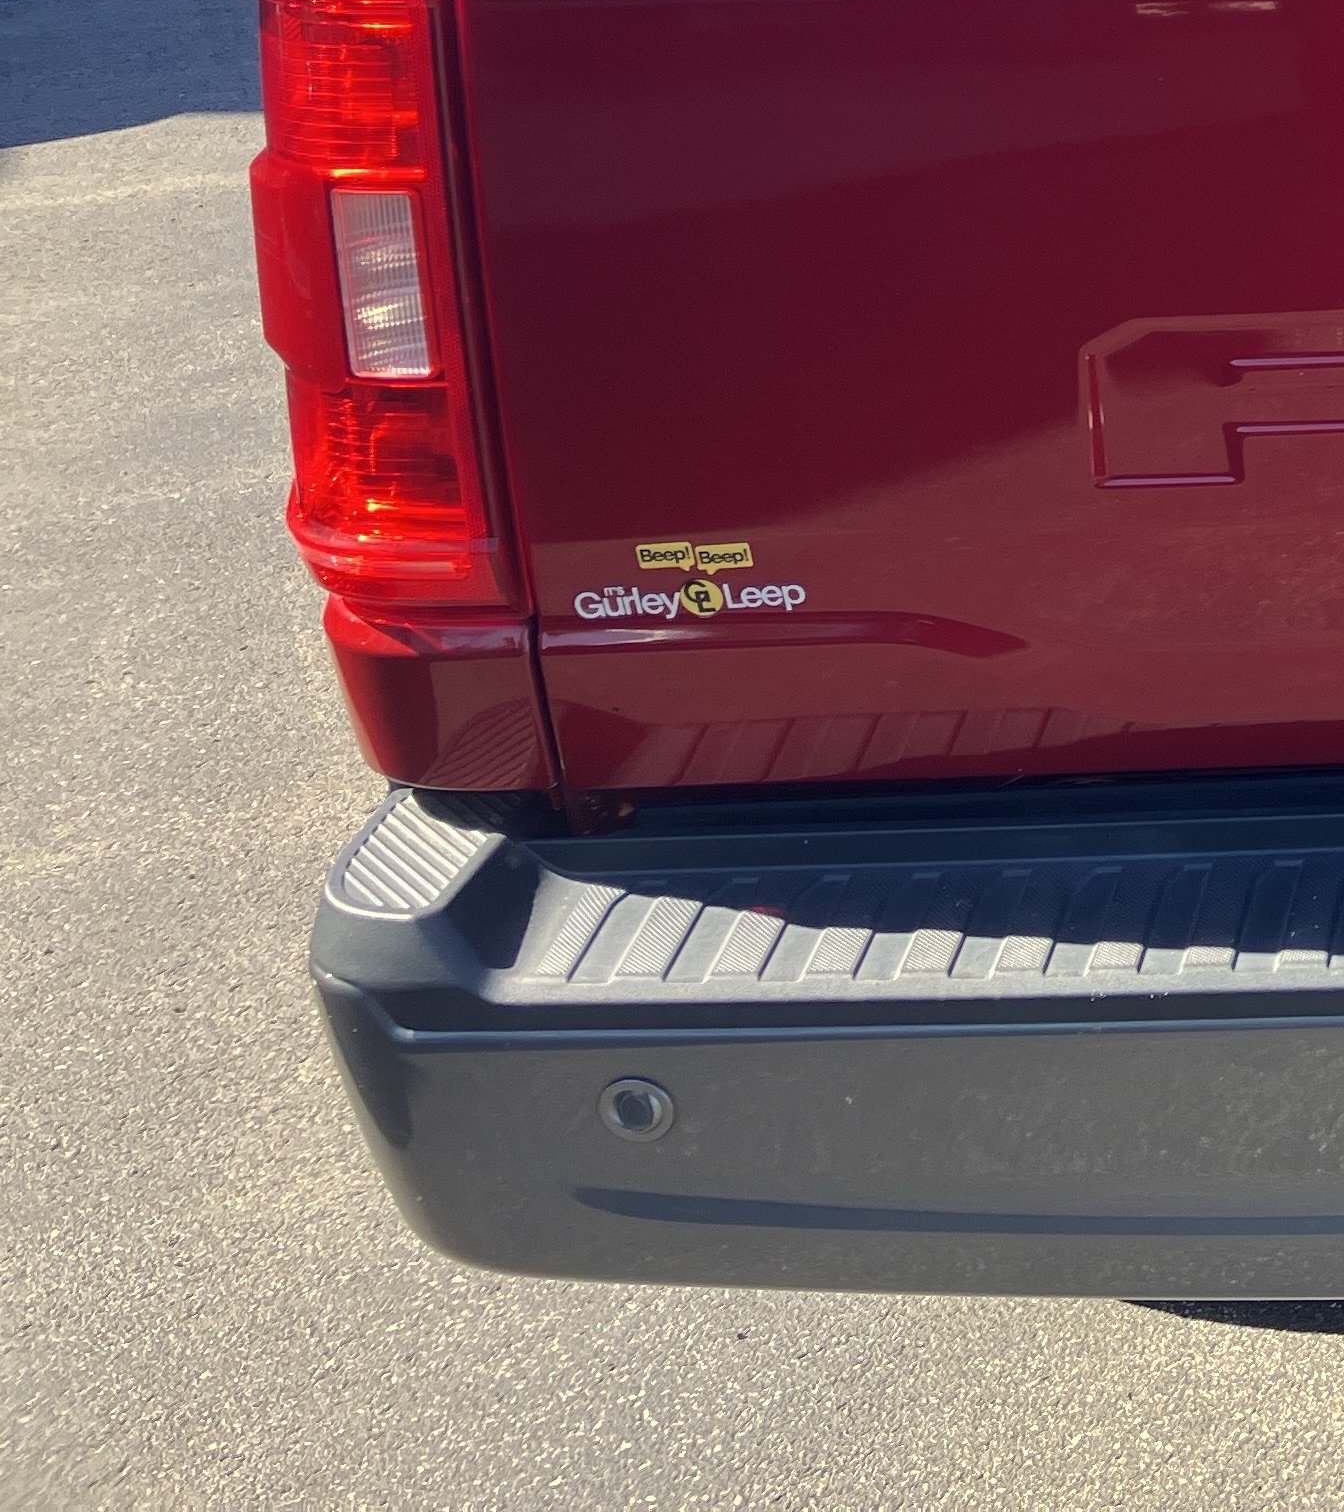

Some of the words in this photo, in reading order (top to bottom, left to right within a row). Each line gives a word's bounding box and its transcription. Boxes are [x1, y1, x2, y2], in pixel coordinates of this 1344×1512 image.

[640, 546, 691, 564] Beep!
[699, 548, 749, 565] Beep!
[574, 587, 681, 619] Gurley
[722, 582, 806, 611] Leep
